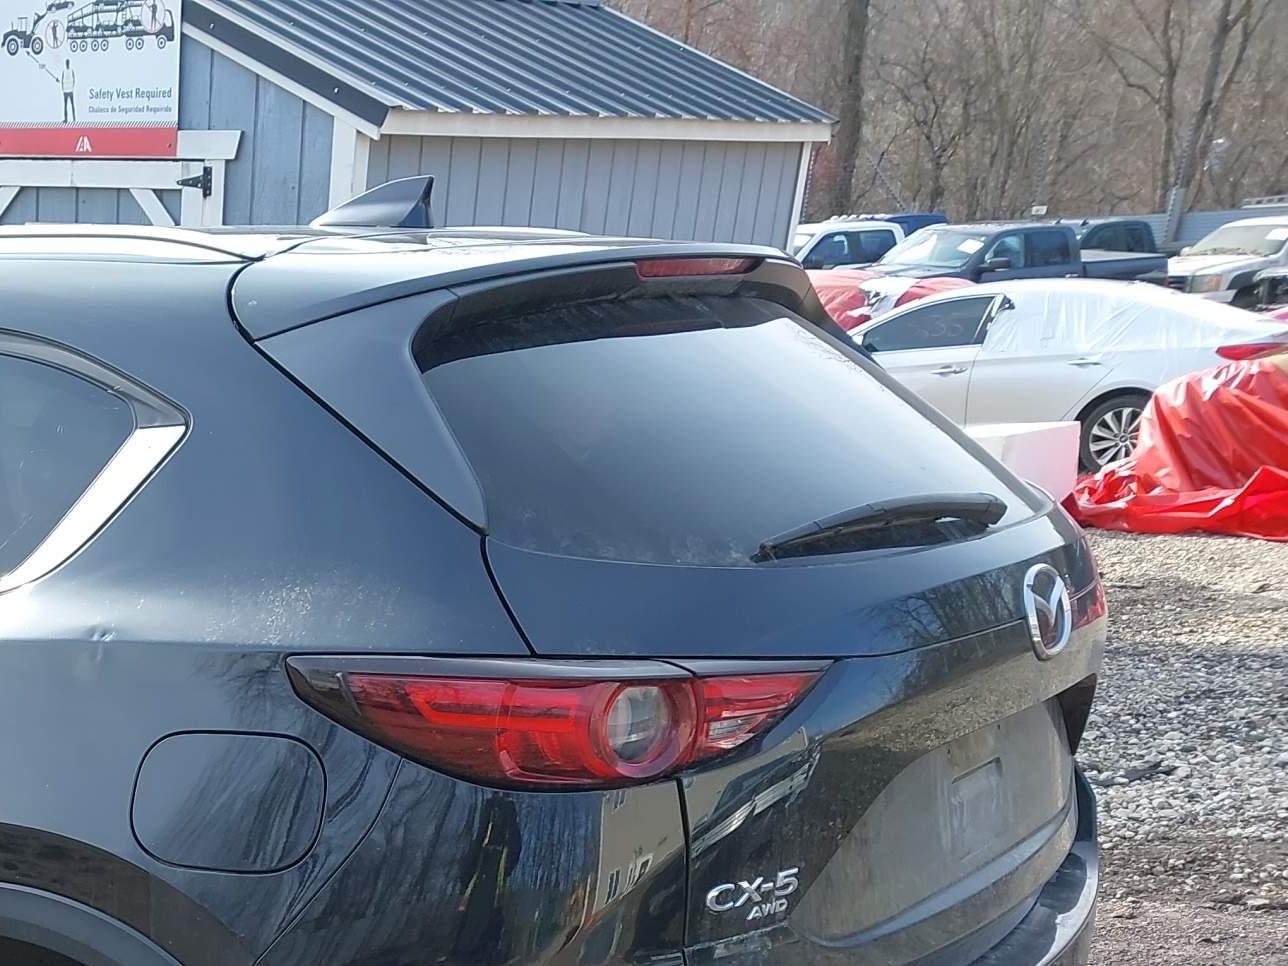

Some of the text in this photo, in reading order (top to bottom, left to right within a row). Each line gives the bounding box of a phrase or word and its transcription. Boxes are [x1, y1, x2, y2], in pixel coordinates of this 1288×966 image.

[89, 88, 172, 101] Safety Vest Required
[706, 867, 799, 912] CX-5
[746, 898, 788, 920] AWD
